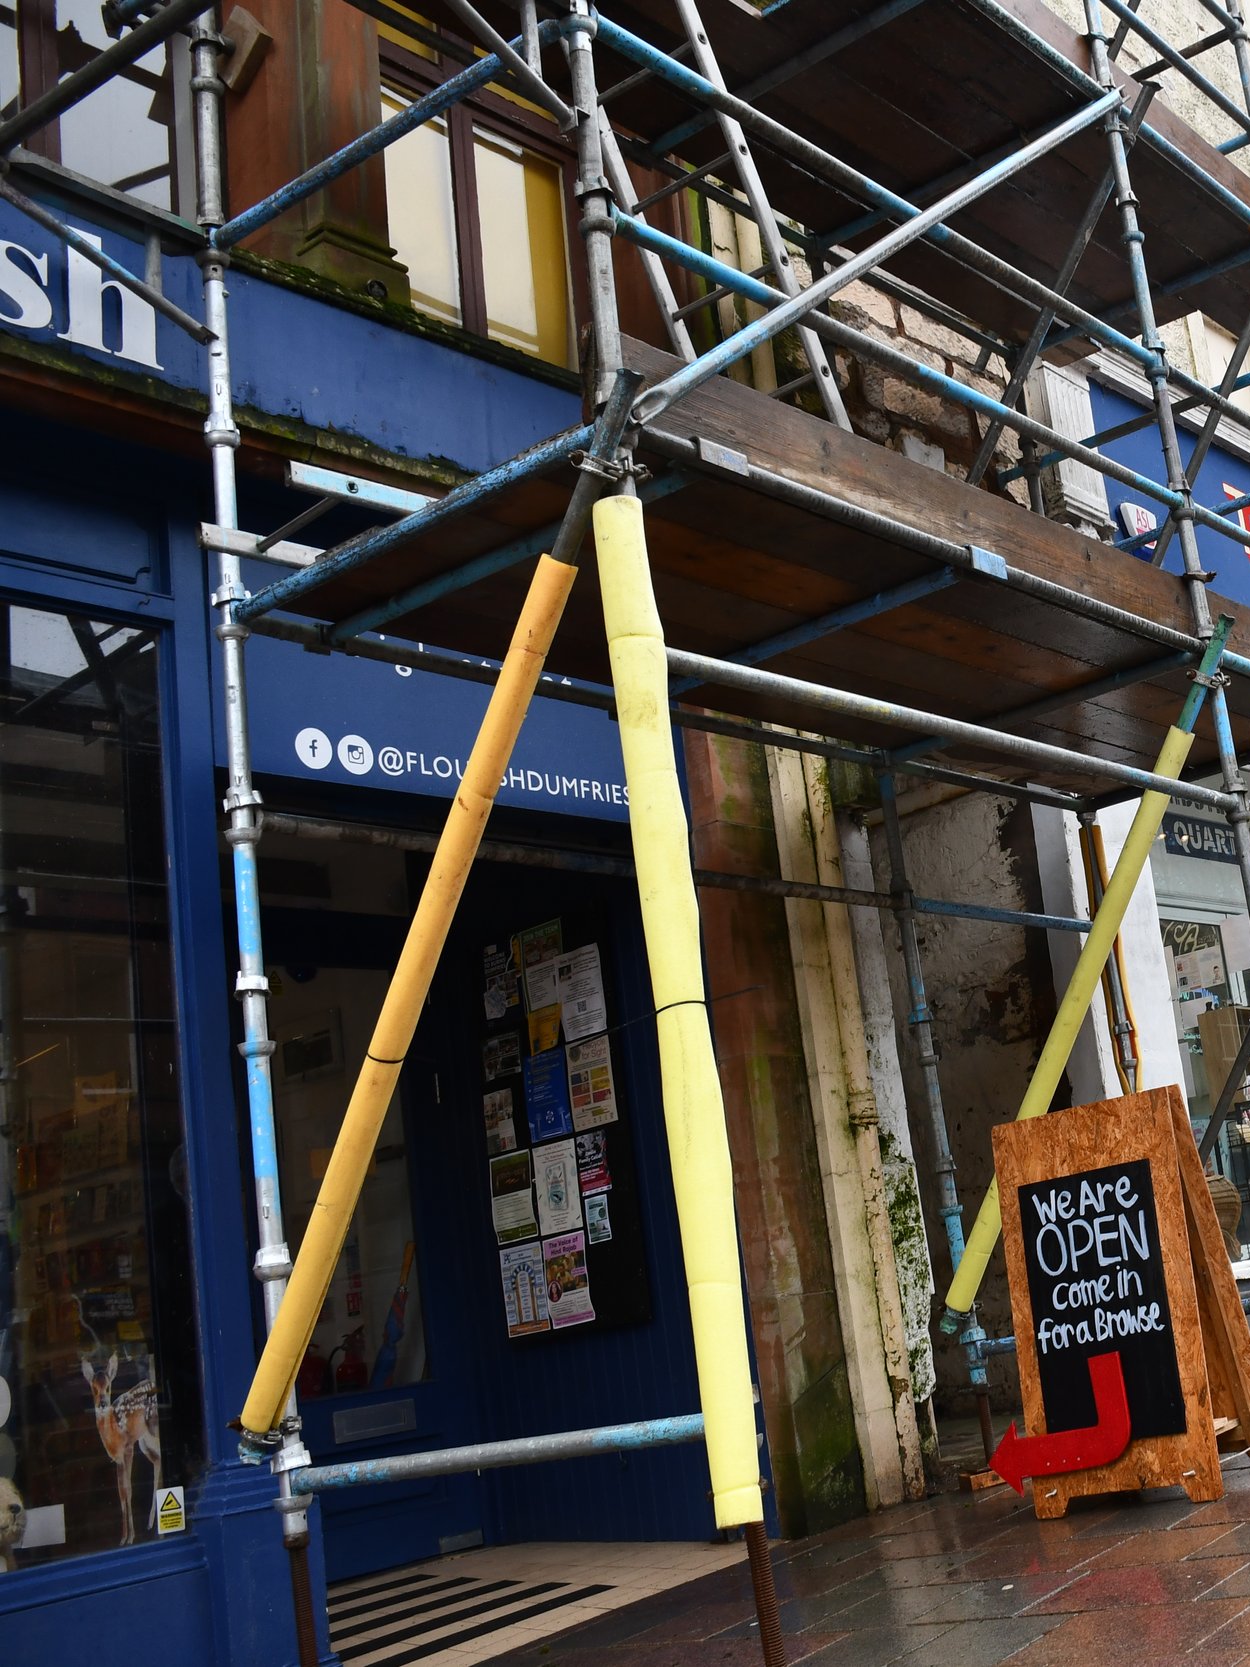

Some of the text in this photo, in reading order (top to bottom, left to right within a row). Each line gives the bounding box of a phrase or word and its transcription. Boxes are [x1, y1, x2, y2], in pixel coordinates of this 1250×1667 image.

[1031, 1175, 1139, 1226] We Are
[548, 1242, 557, 1250] The
[558, 1239, 571, 1248] Voice
[1036, 1209, 1150, 1277] OPEN
[1115, 1265, 1143, 1299] in
[1038, 1302, 1166, 1354] for a Browse
